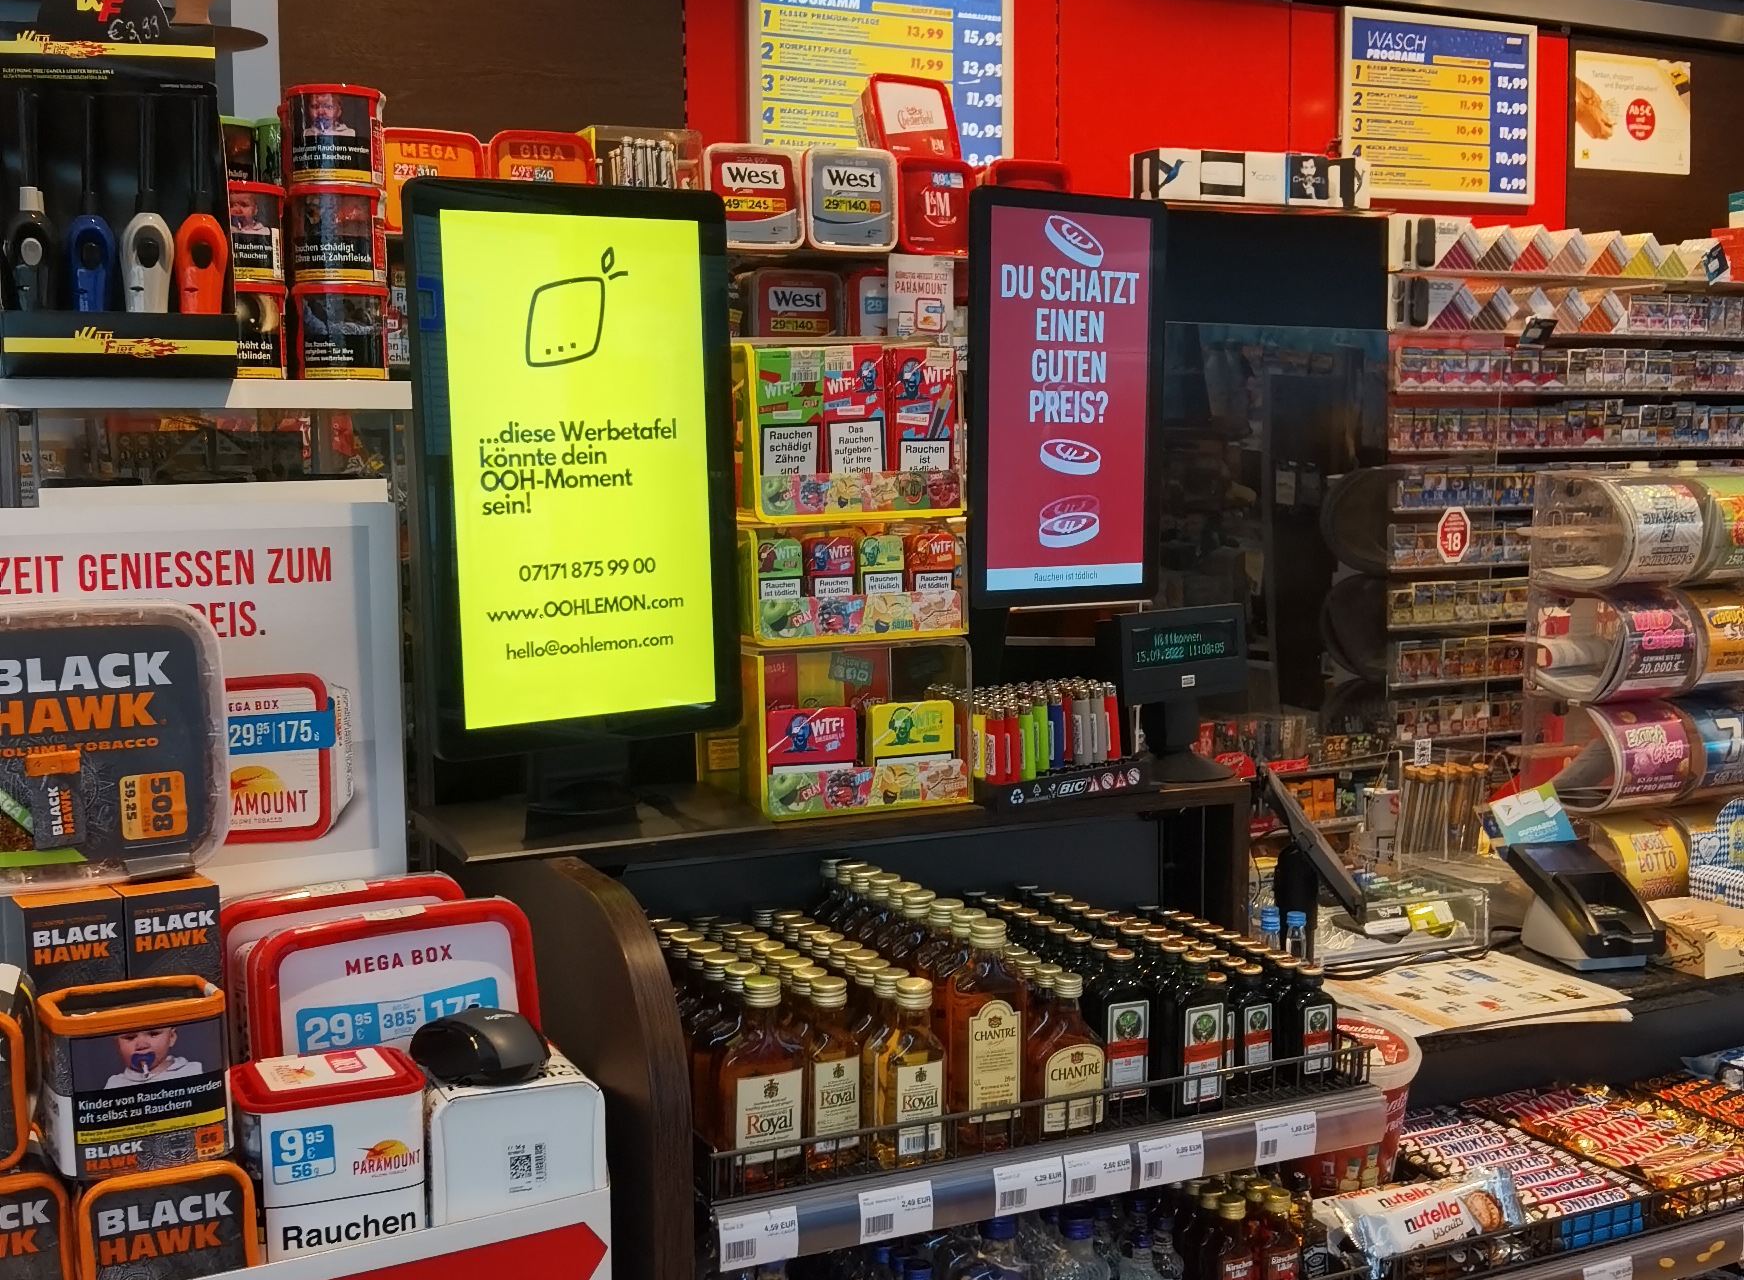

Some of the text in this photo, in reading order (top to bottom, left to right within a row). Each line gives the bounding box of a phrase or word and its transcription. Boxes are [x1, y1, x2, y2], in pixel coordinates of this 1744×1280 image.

[764, 9, 771, 27] 1
[906, 25, 944, 39] 13,99
[963, 29, 1003, 47] 15,99
[1367, 31, 1427, 51] WASCH
[761, 42, 1003, 78] 2 11,99 13,99
[1366, 48, 1425, 63] PROGRAMM
[1355, 64, 1362, 80] 1
[762, 74, 1003, 107] 3 11,99
[1352, 91, 1363, 107] 2
[762, 106, 1003, 138] 4 10,99
[1352, 117, 1363, 133] 3
[401, 143, 457, 160] MEGA
[520, 145, 565, 160] GIGA
[727, 167, 780, 186] West
[827, 170, 877, 188] West
[894, 281, 948, 296] PARAMOUNT
[1001, 264, 1034, 299] DU
[773, 290, 822, 309] West
[1036, 308, 1105, 344] EINEN
[1031, 348, 1107, 384] GUTEN
[1029, 390, 1109, 424] PREIS?
[559, 418, 677, 443] Werbetafel
[769, 429, 813, 442] Rauchen
[838, 434, 874, 445] Rauchen
[479, 444, 607, 468] könnte dein
[769, 441, 812, 453] schädigt
[775, 453, 806, 464] Zähne
[905, 443, 945, 455] Rauchen
[480, 468, 633, 492] OOH-Moment
[481, 492, 532, 516] sein!
[0, 547, 333, 595] ZEIT GENIESSEN ZUM
[486, 594, 684, 623] www.OOHLEMON.com
[506, 634, 674, 660] hello@oohlemon.com
[0, 650, 173, 694] BLACK
[0, 691, 158, 737] HAWK
[255, 699, 280, 712] BOX
[810, 717, 845, 735] WTF!
[76, 737, 159, 752] TOBACCO
[1059, 779, 1086, 795] BIC
[52, 785, 63, 837] BLACK
[61, 788, 73, 835] HAWK
[33, 921, 118, 948] BLACK
[134, 910, 216, 936] BLACK
[135, 927, 209, 953] HAWK
[34, 941, 110, 966] HAWK
[345, 943, 453, 977] MEGA BOX
[304, 1011, 353, 1051] 29
[974, 1025, 1018, 1042] CHANTRÉ
[1050, 1062, 1101, 1082] CHANTRÉ
[78, 1080, 222, 1112] Kinder von Rauchern werden
[820, 1086, 856, 1108] Royal
[79, 1099, 193, 1125] oft selbst zu Rauchern
[745, 1107, 794, 1136] Royal
[279, 1129, 304, 1163] 9
[1419, 1124, 1482, 1147] SNICKERS
[1442, 1132, 1505, 1159] SNICKERS
[84, 1140, 143, 1159] BLACK
[353, 1148, 422, 1177] PARAMOUNT
[1378, 1186, 1435, 1208] nutella
[1559, 1188, 1627, 1213] SNICKERS
[100, 1189, 234, 1236] BLACK
[1404, 1200, 1462, 1234] nutella
[281, 1207, 418, 1251] Rauchen
[1432, 1217, 1464, 1240] biscuits
[101, 1222, 223, 1267] HAWK
